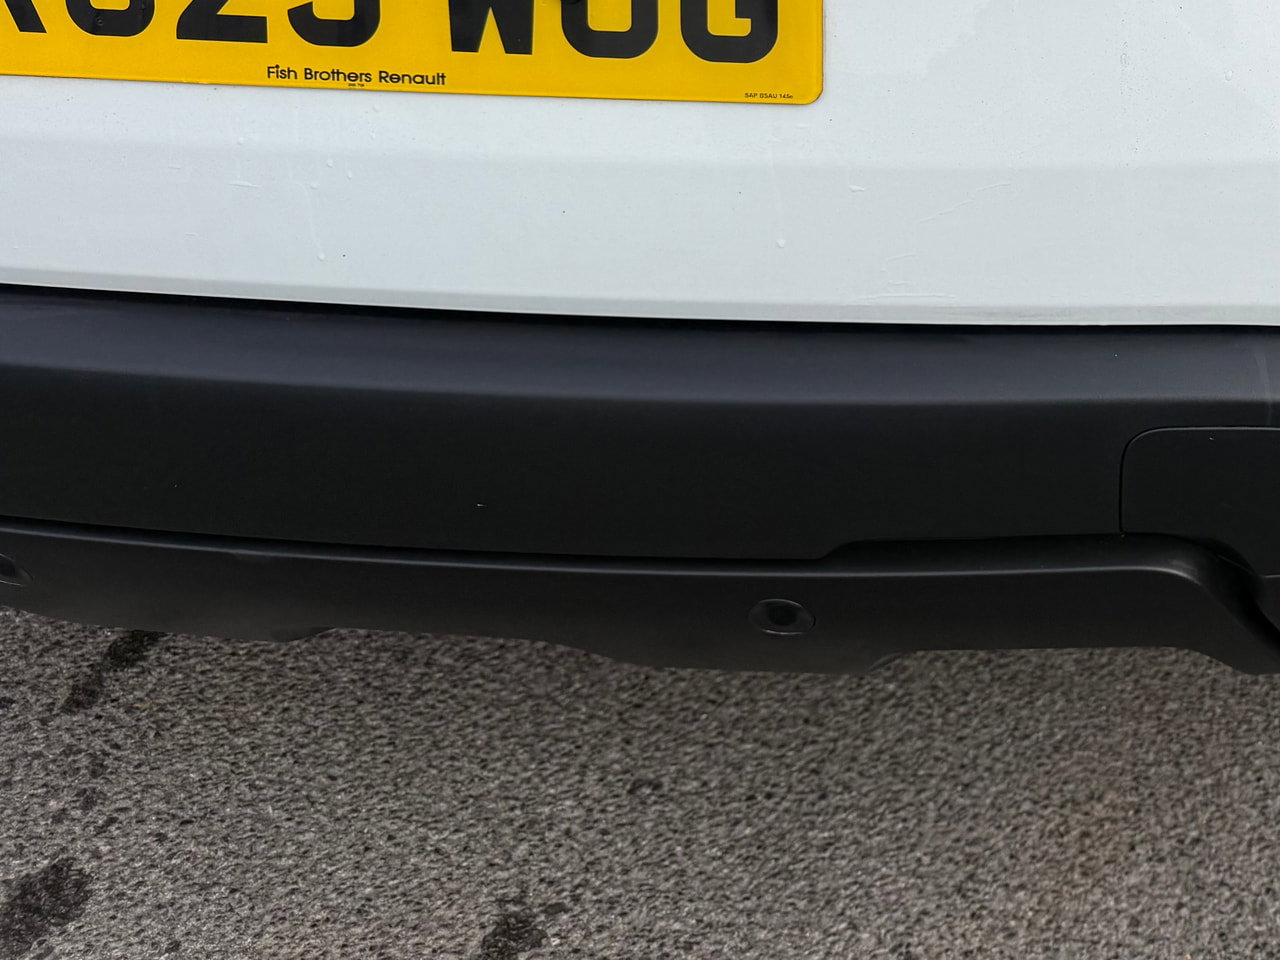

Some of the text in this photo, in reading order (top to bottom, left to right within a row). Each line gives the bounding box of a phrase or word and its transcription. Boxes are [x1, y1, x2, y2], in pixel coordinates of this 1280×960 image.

[267, 64, 446, 86] Fish Brothers Renault
